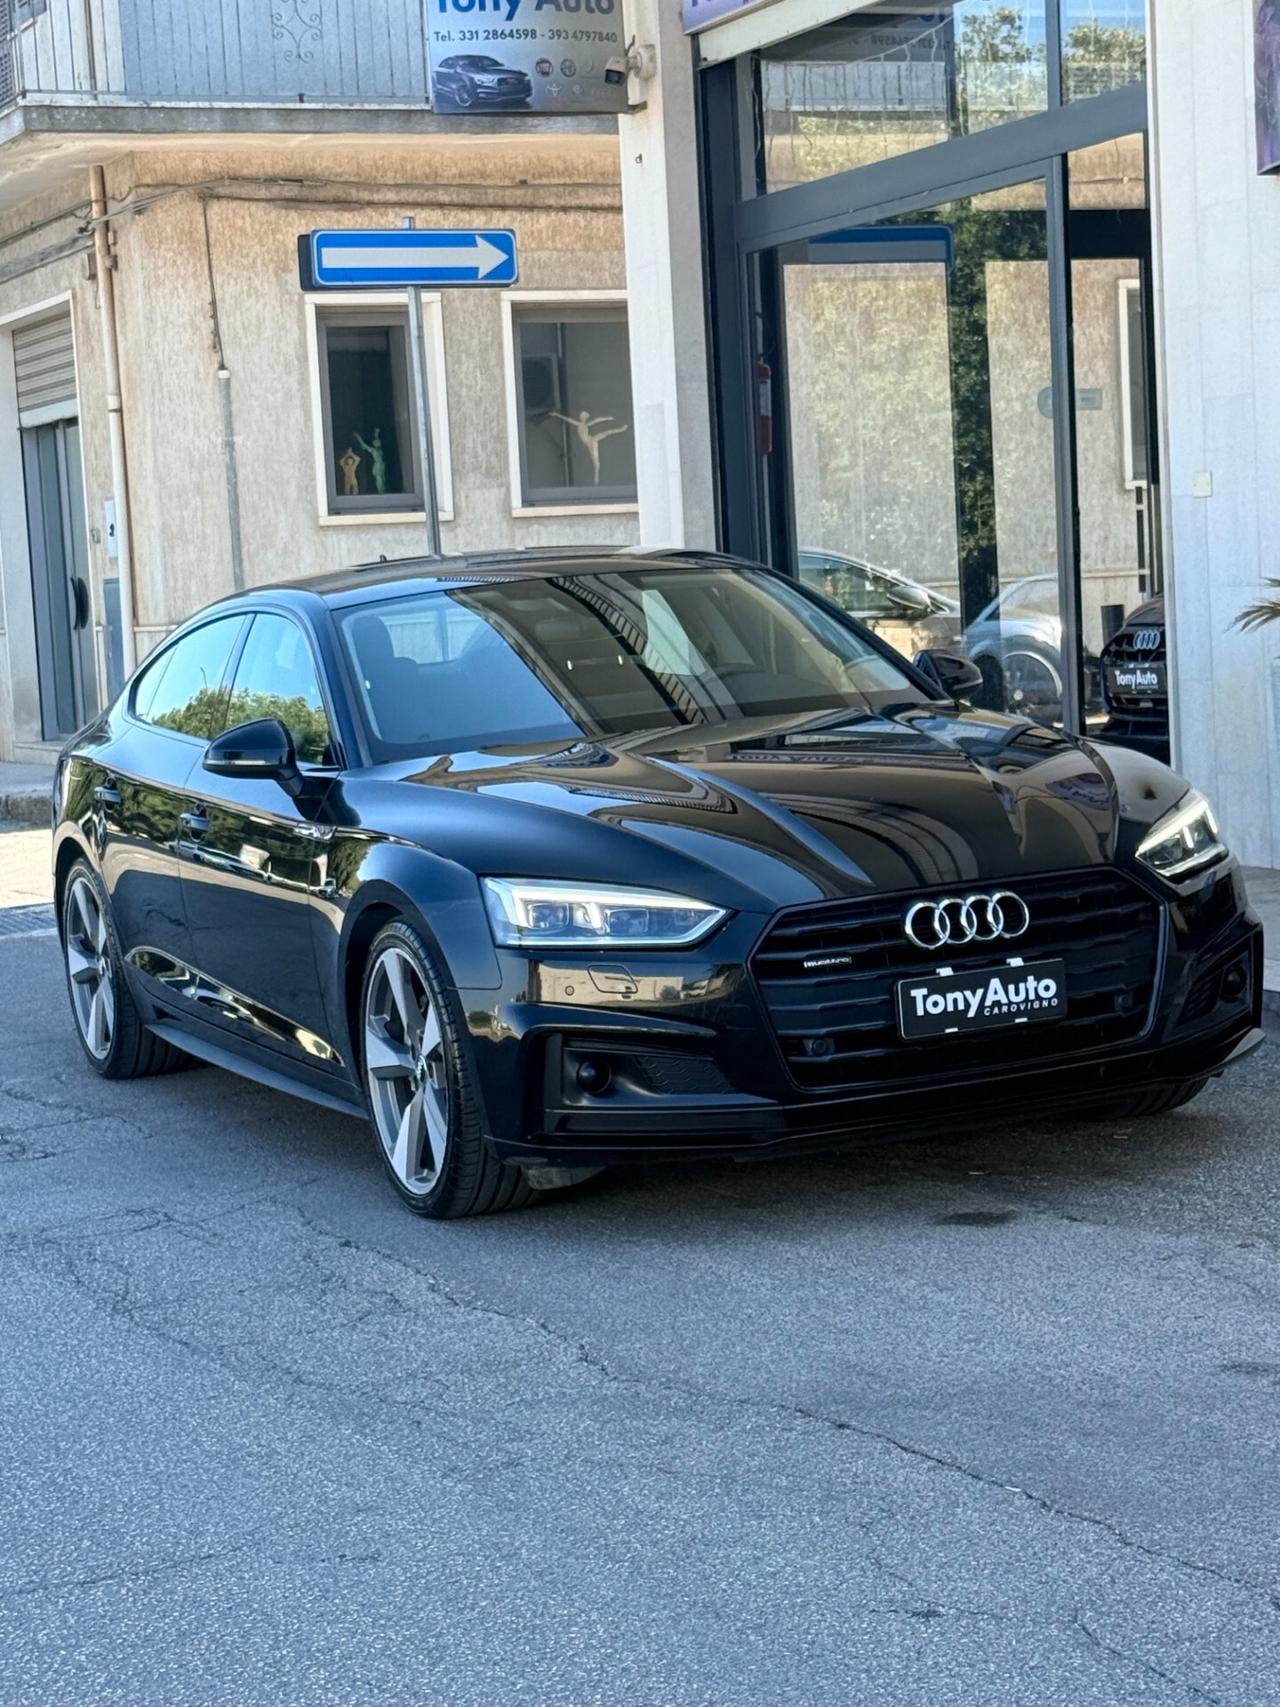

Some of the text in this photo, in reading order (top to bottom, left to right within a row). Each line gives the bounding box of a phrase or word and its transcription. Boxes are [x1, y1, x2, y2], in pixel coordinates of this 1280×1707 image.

[434, 31, 455, 42] Tel.
[459, 30, 479, 41] 331
[483, 29, 537, 41] 2864598
[548, 29, 569, 41] 393
[571, 30, 618, 43] 4797840
[984, 998, 1058, 1016] CAROVIGNO
